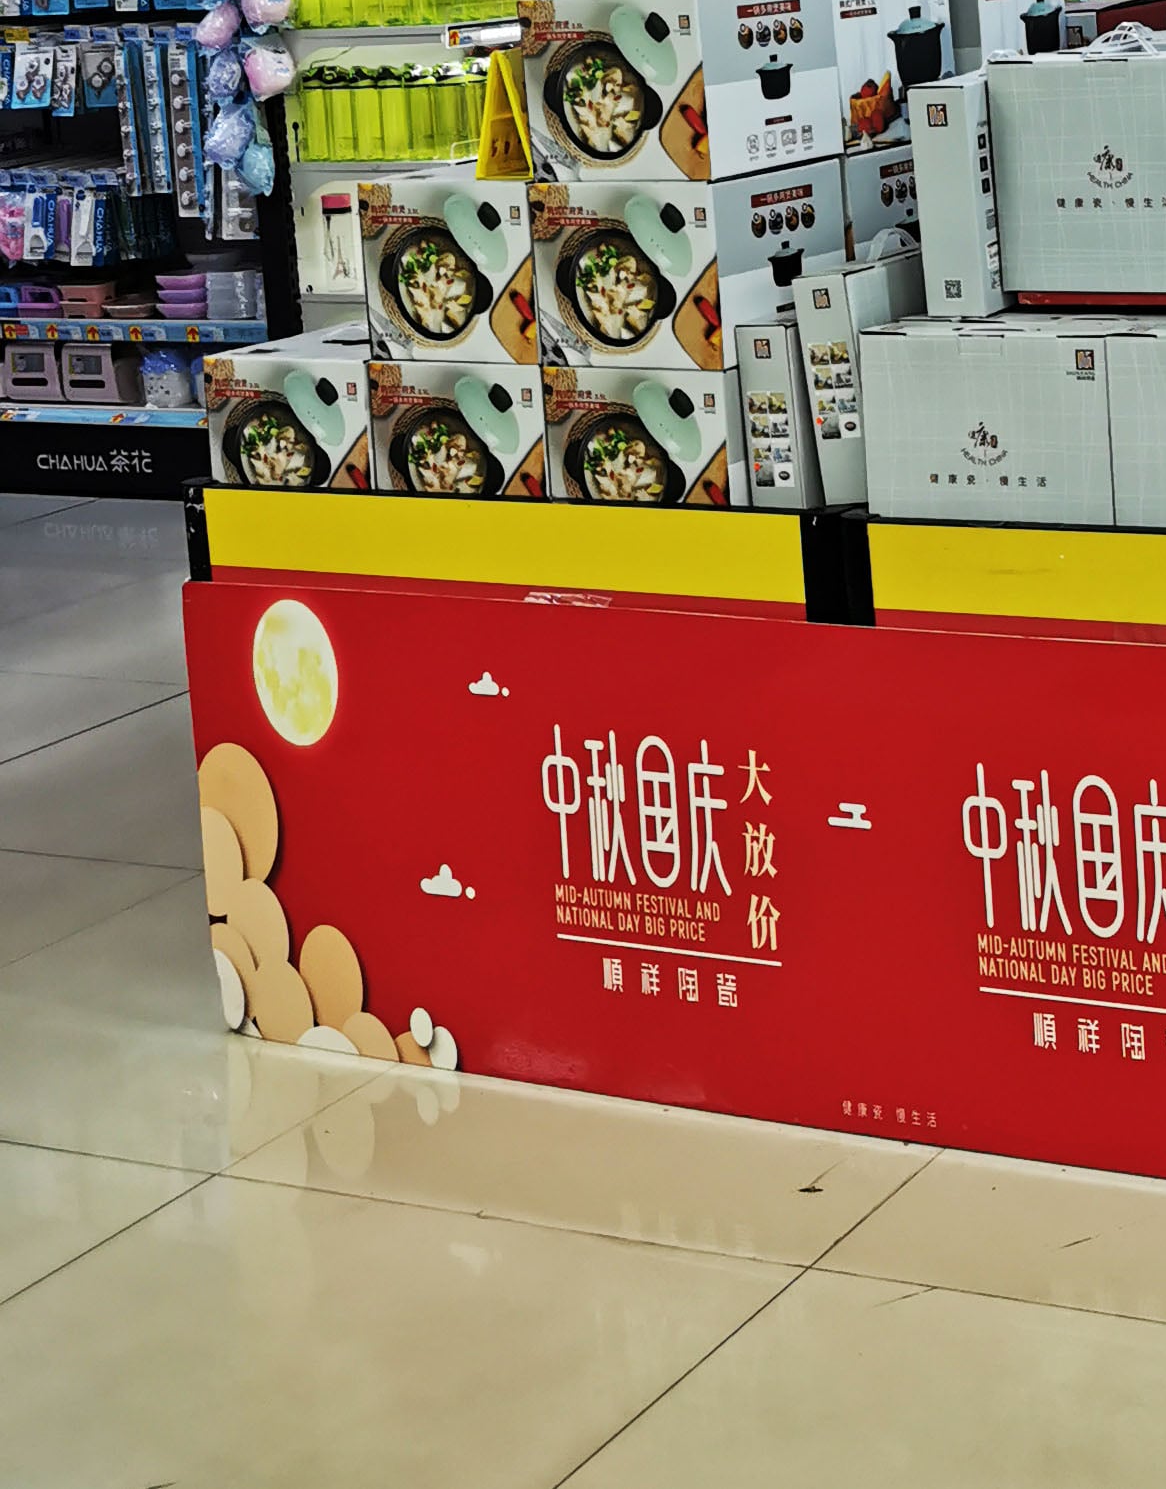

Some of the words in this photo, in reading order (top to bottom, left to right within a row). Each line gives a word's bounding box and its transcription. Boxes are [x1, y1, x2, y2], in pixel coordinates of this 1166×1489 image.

[541, 723, 733, 897] 中秋国庆
[737, 749, 781, 952] 大放价
[555, 884, 632, 911] MID-AUTUMN
[635, 892, 689, 917] FESTIVAL
[695, 900, 721, 923] AND
[556, 905, 614, 932] NATIONAL
[618, 913, 640, 934] DAY
[645, 916, 666, 937] BIG
[670, 920, 706, 942] PRICE
[977, 932, 1067, 963] MID-AUTUMN
[1072, 943, 1137, 971] FESTIVAL
[978, 957, 1046, 985] NATIONAL
[1051, 964, 1077, 988] DAY
[1082, 968, 1106, 991] BIG
[1112, 972, 1154, 996] PRICE
